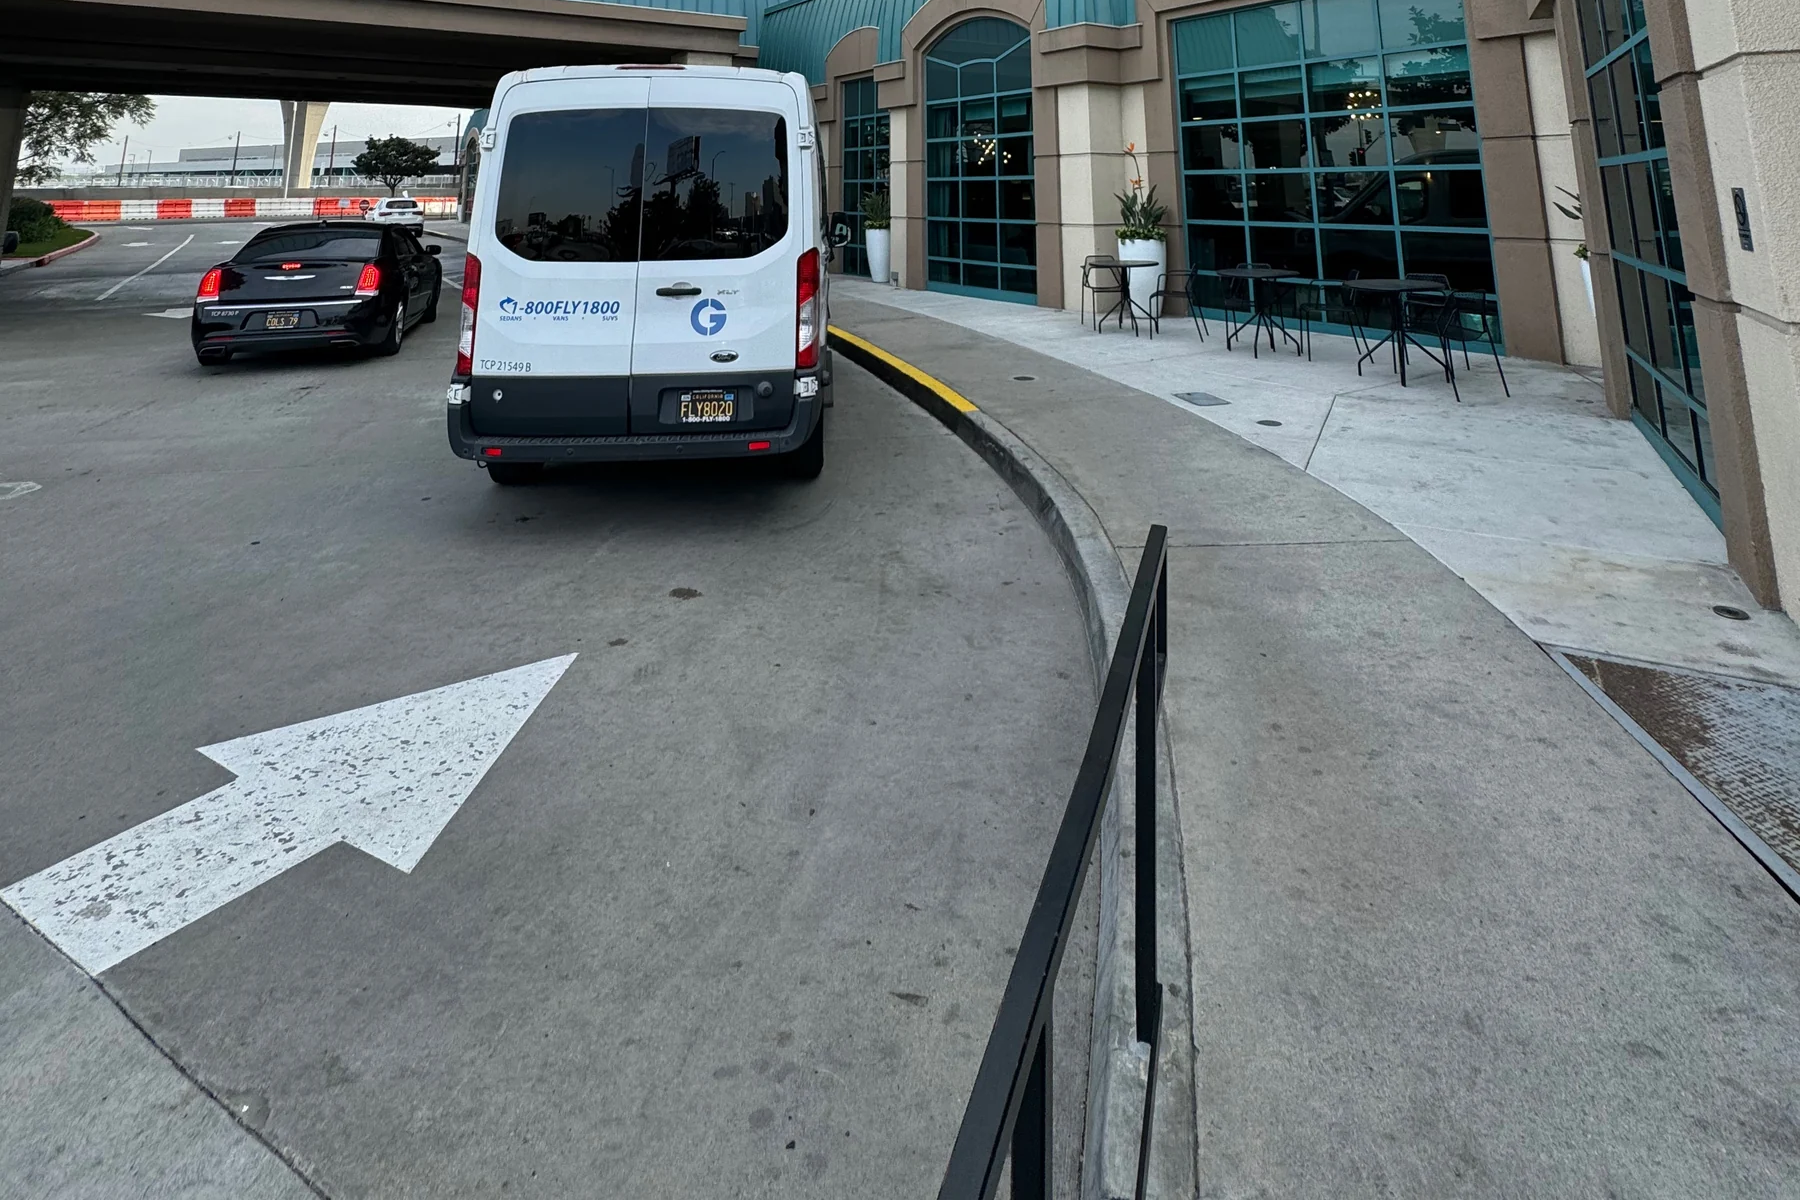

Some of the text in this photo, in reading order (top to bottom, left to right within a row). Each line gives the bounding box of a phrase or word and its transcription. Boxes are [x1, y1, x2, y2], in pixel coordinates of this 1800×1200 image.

[511, 300, 620, 315] 1-800FLY1800
[690, 298, 727, 336] G
[480, 359, 532, 373] TCP 21549 B
[680, 400, 733, 417] FLY8020
